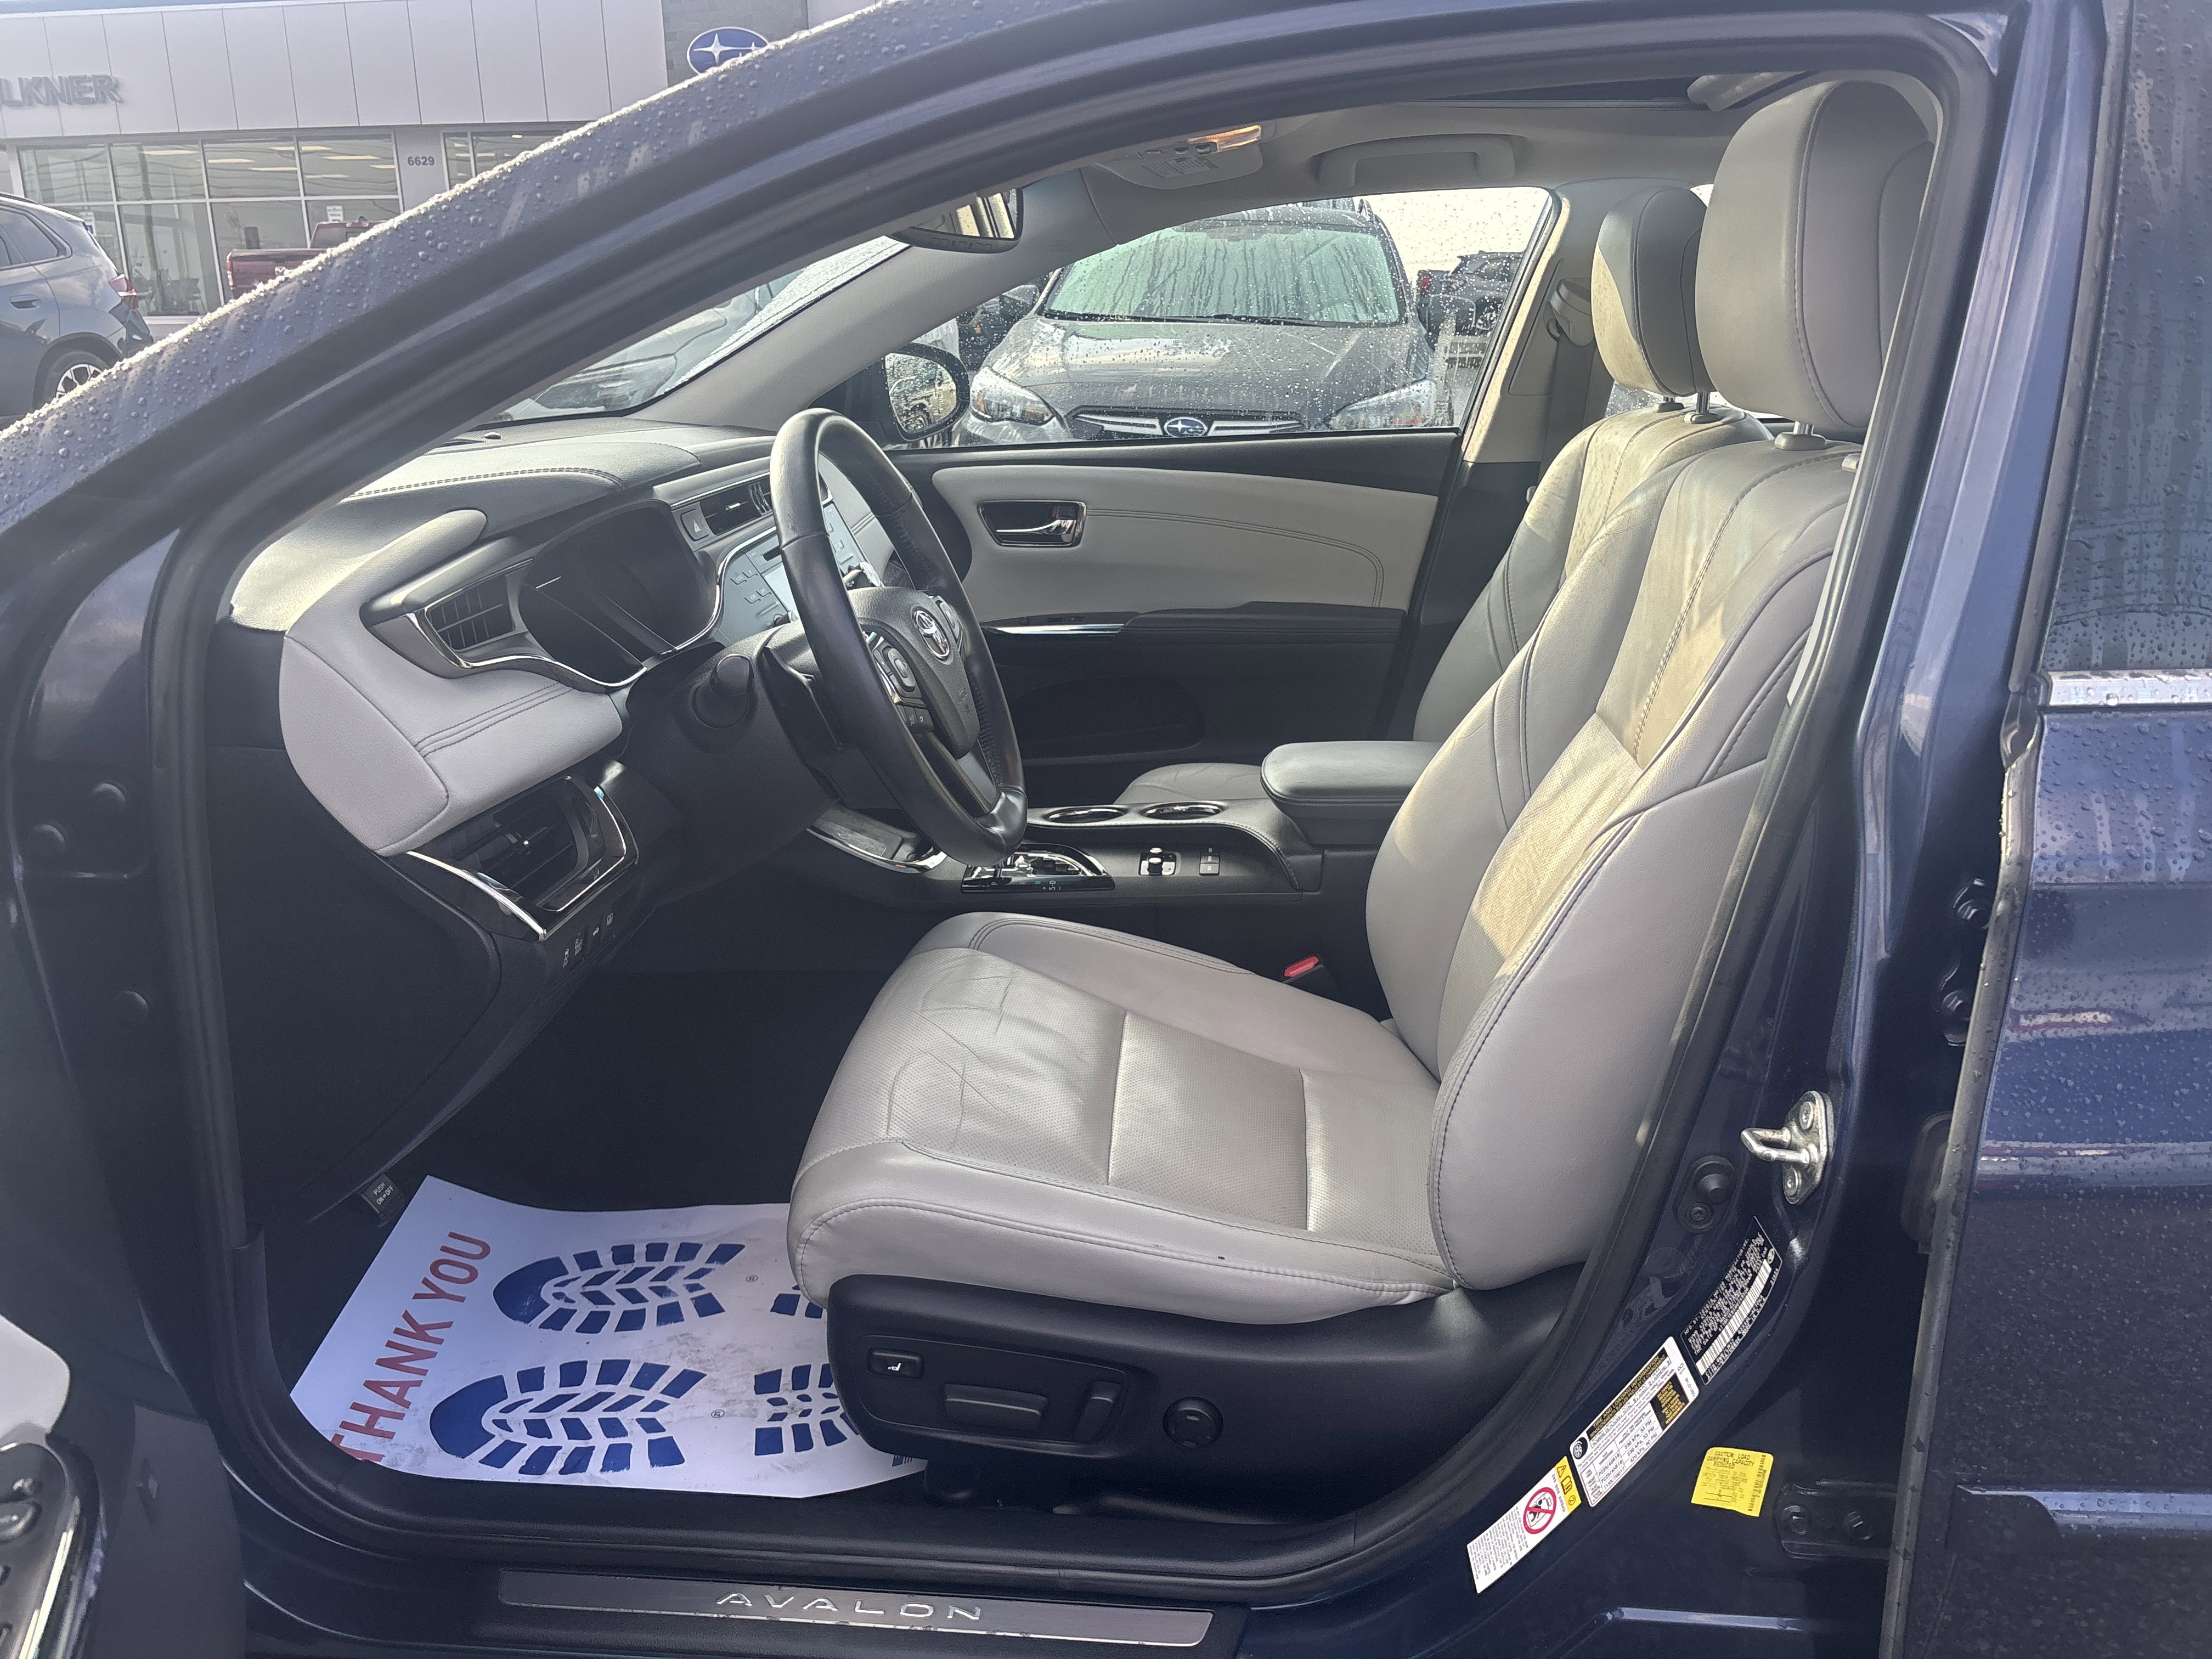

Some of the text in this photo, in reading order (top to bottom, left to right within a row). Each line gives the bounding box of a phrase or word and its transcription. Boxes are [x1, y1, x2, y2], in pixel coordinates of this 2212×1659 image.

[408, 156, 435, 166] 6629
[374, 1182, 386, 1195] PUSH
[330, 1231, 491, 1463] THANK YOU
[1677, 1362, 1686, 1375] 18
[1593, 1416, 1603, 1429] TIRE
[1602, 1406, 1612, 1419] AND
[1612, 1386, 1631, 1408] LOADING
[1630, 1355, 1660, 1388] INFORMATION
[1732, 1459, 1754, 1467] CAPACITY
[715, 1593, 982, 1621] AVALON
